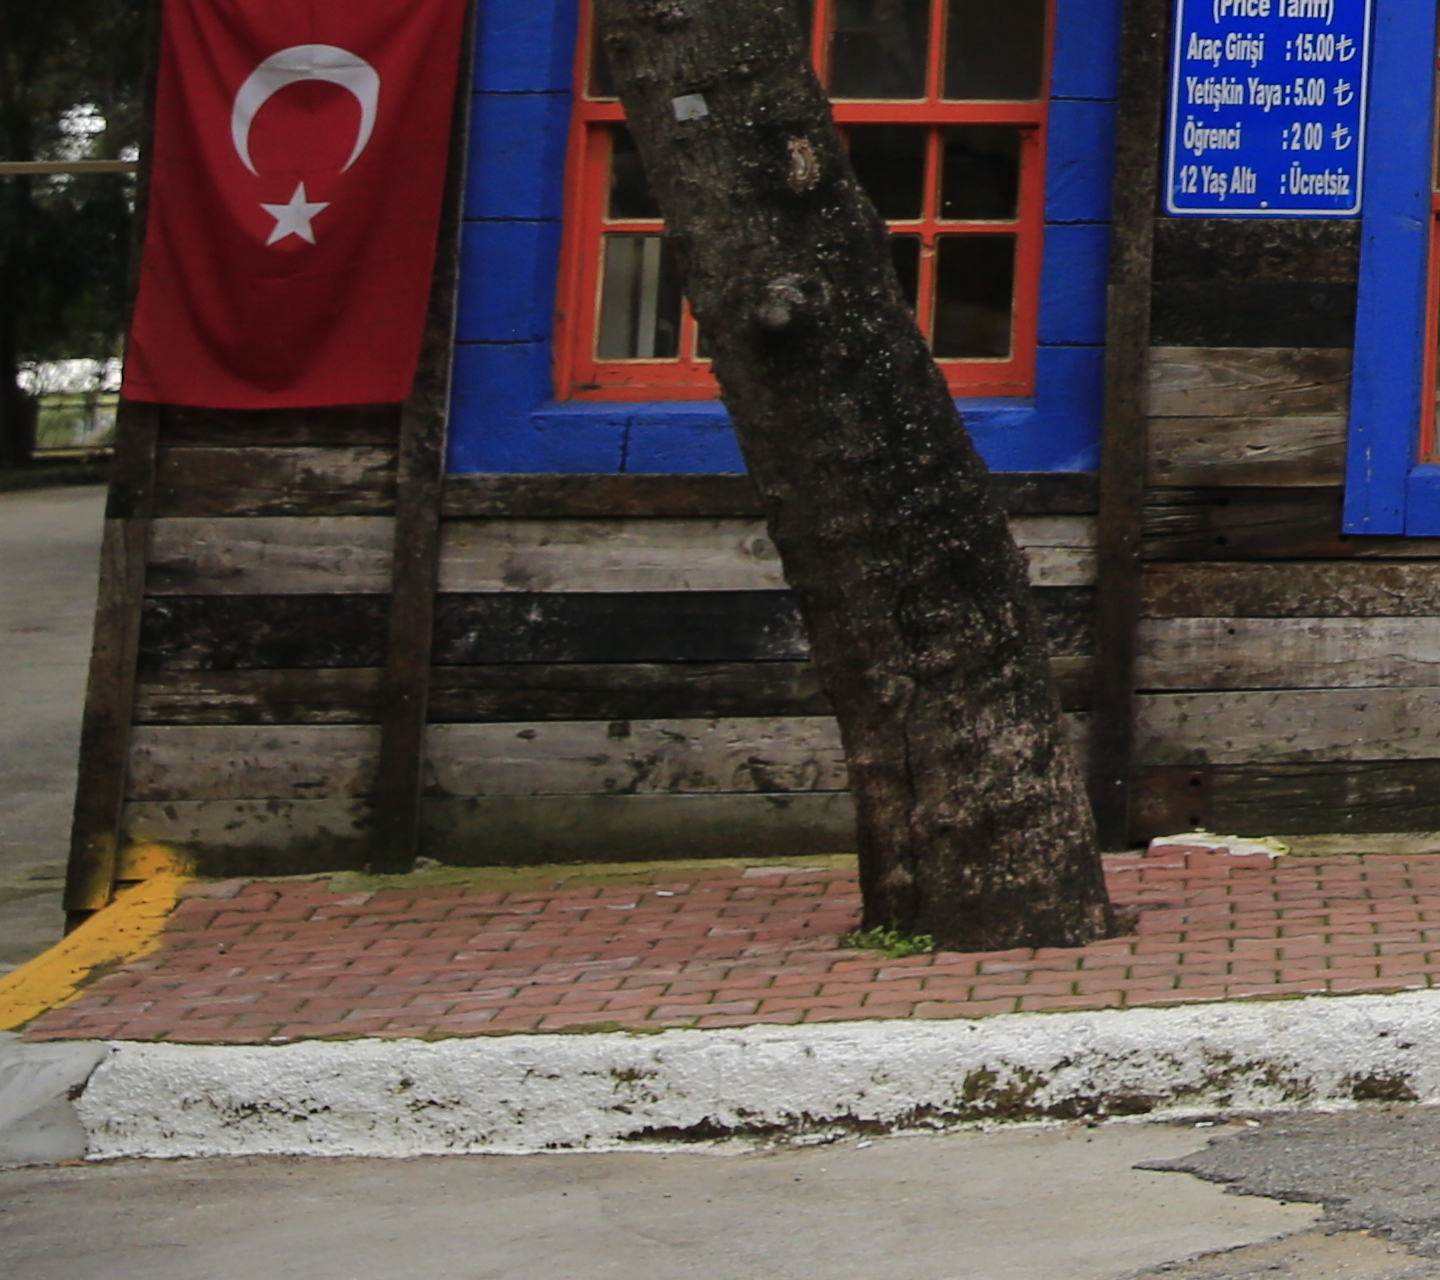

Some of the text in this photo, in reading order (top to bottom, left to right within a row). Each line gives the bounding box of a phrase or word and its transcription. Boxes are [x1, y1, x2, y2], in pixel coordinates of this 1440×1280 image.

[1186, 32, 1222, 68] Araç
[1225, 32, 1265, 68] Girişi
[1186, 76, 1244, 112] Yetişkin
[1247, 77, 1282, 113] Yaya
[1183, 115, 1242, 156] Öğrenci
[1179, 165, 1198, 194] 12
[1201, 165, 1228, 202] Yaş
[1230, 166, 1257, 194] Altı
[1289, 161, 1350, 196] Ücretsiz
